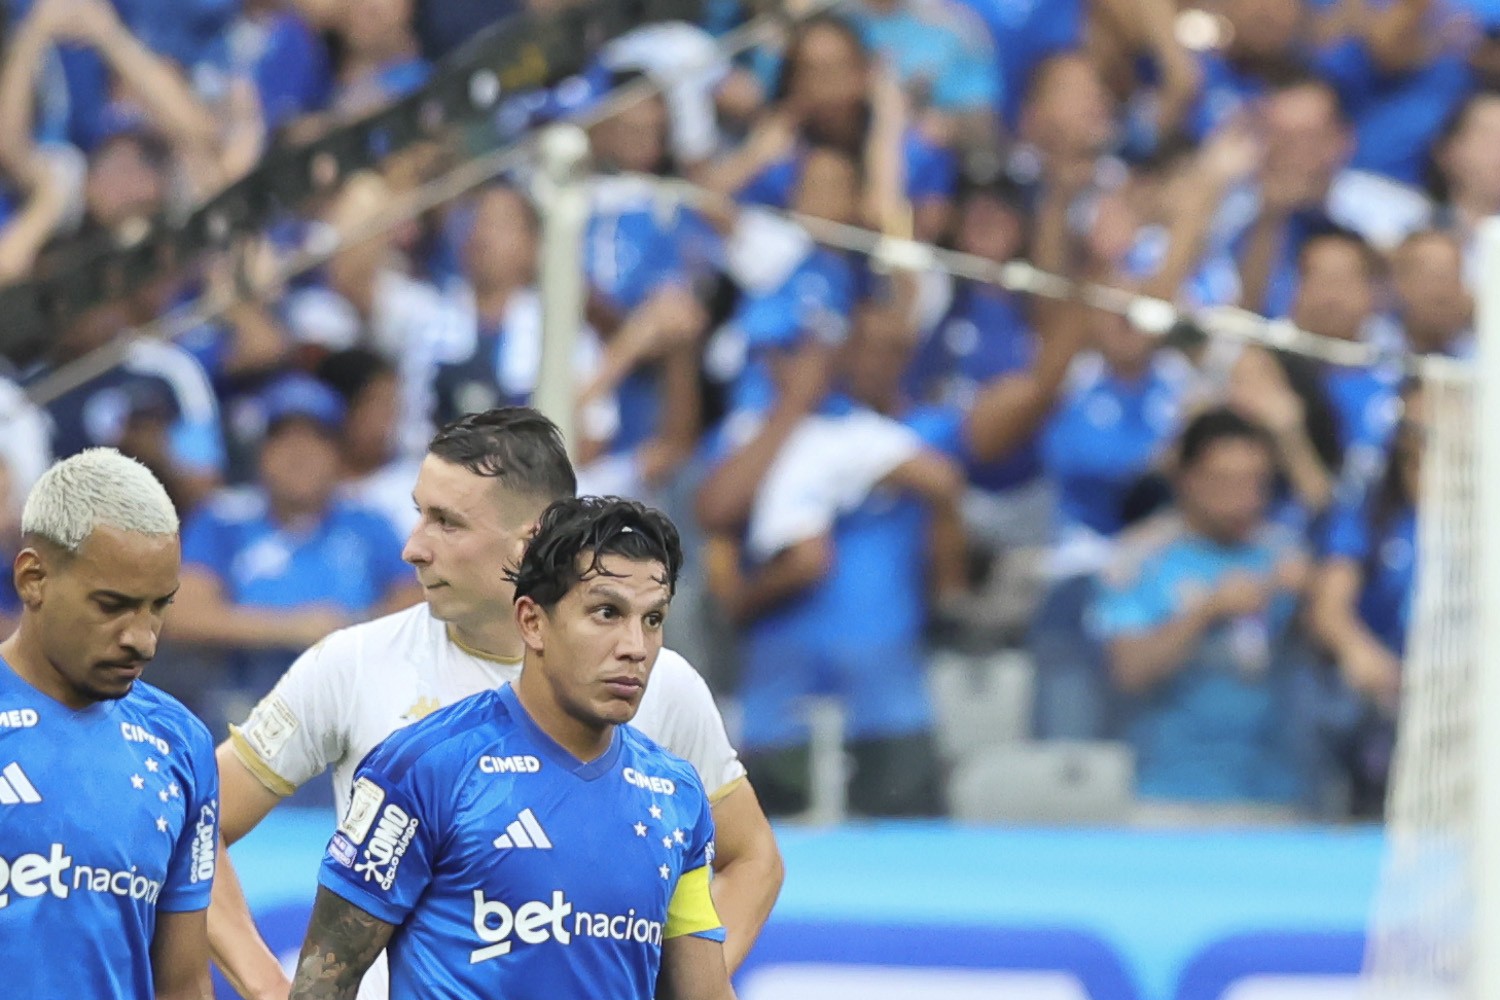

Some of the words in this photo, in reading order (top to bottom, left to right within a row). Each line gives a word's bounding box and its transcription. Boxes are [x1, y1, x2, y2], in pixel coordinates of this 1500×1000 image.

[479, 756, 540, 773] CIMED
[623, 767, 676, 795] CIMED
[367, 803, 409, 867] OMO
